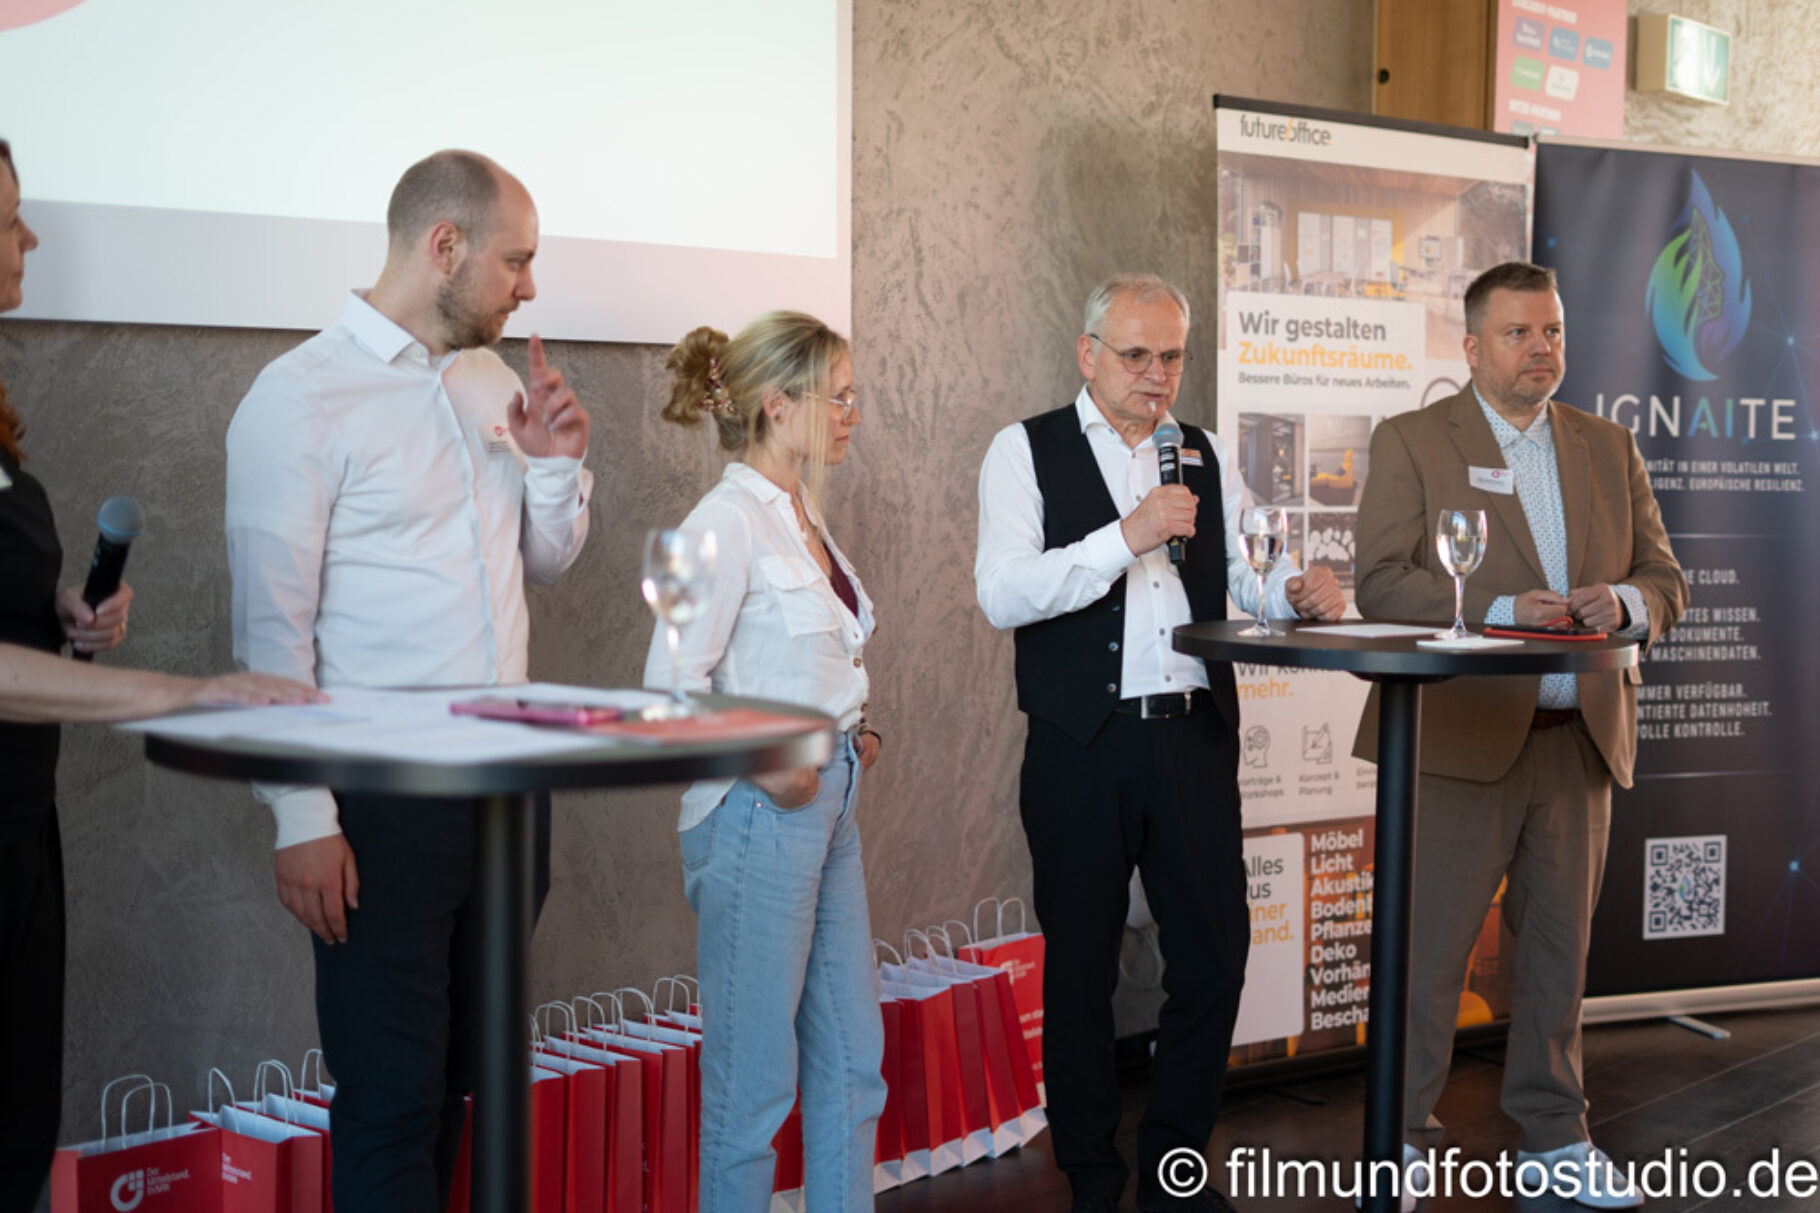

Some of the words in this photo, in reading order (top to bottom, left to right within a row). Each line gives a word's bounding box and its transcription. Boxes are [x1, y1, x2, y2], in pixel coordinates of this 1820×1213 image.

[1239, 310, 1279, 336] Wir
[1286, 316, 1386, 343] gestalten
[1238, 341, 1413, 371] Zukunftsräume.
[1239, 372, 1280, 385] Bessere
[1283, 373, 1313, 387] Büros
[1316, 374, 1329, 388] für
[1333, 377, 1362, 388] neues
[1366, 377, 1411, 390] Arbeiten.
[1597, 393, 1796, 440] IGNAITE
[1678, 460, 1689, 473] IN
[1692, 461, 1718, 474] EINER
[1721, 461, 1770, 475] VOLATILEN
[1774, 461, 1801, 475] WELT.
[1689, 475, 1751, 492] EUROPÄISCHE
[1754, 479, 1806, 492] RESILIENZ.
[1698, 569, 1739, 585] CLOUD.
[1712, 606, 1761, 623] WISSEN.
[1670, 626, 1745, 643] DOKUMENTE.
[1651, 645, 1763, 662] MASCHINENDATEN.
[1238, 677, 1294, 700] mehr.
[1676, 680, 1748, 700] VERFÜGBAR.
[1690, 701, 1773, 719] DATENHOHEIT.
[1674, 720, 1746, 738] KONTROLLE.
[1311, 828, 1364, 852] Möbel
[1311, 853, 1354, 875] Licht
[1311, 941, 1358, 965] Deko
